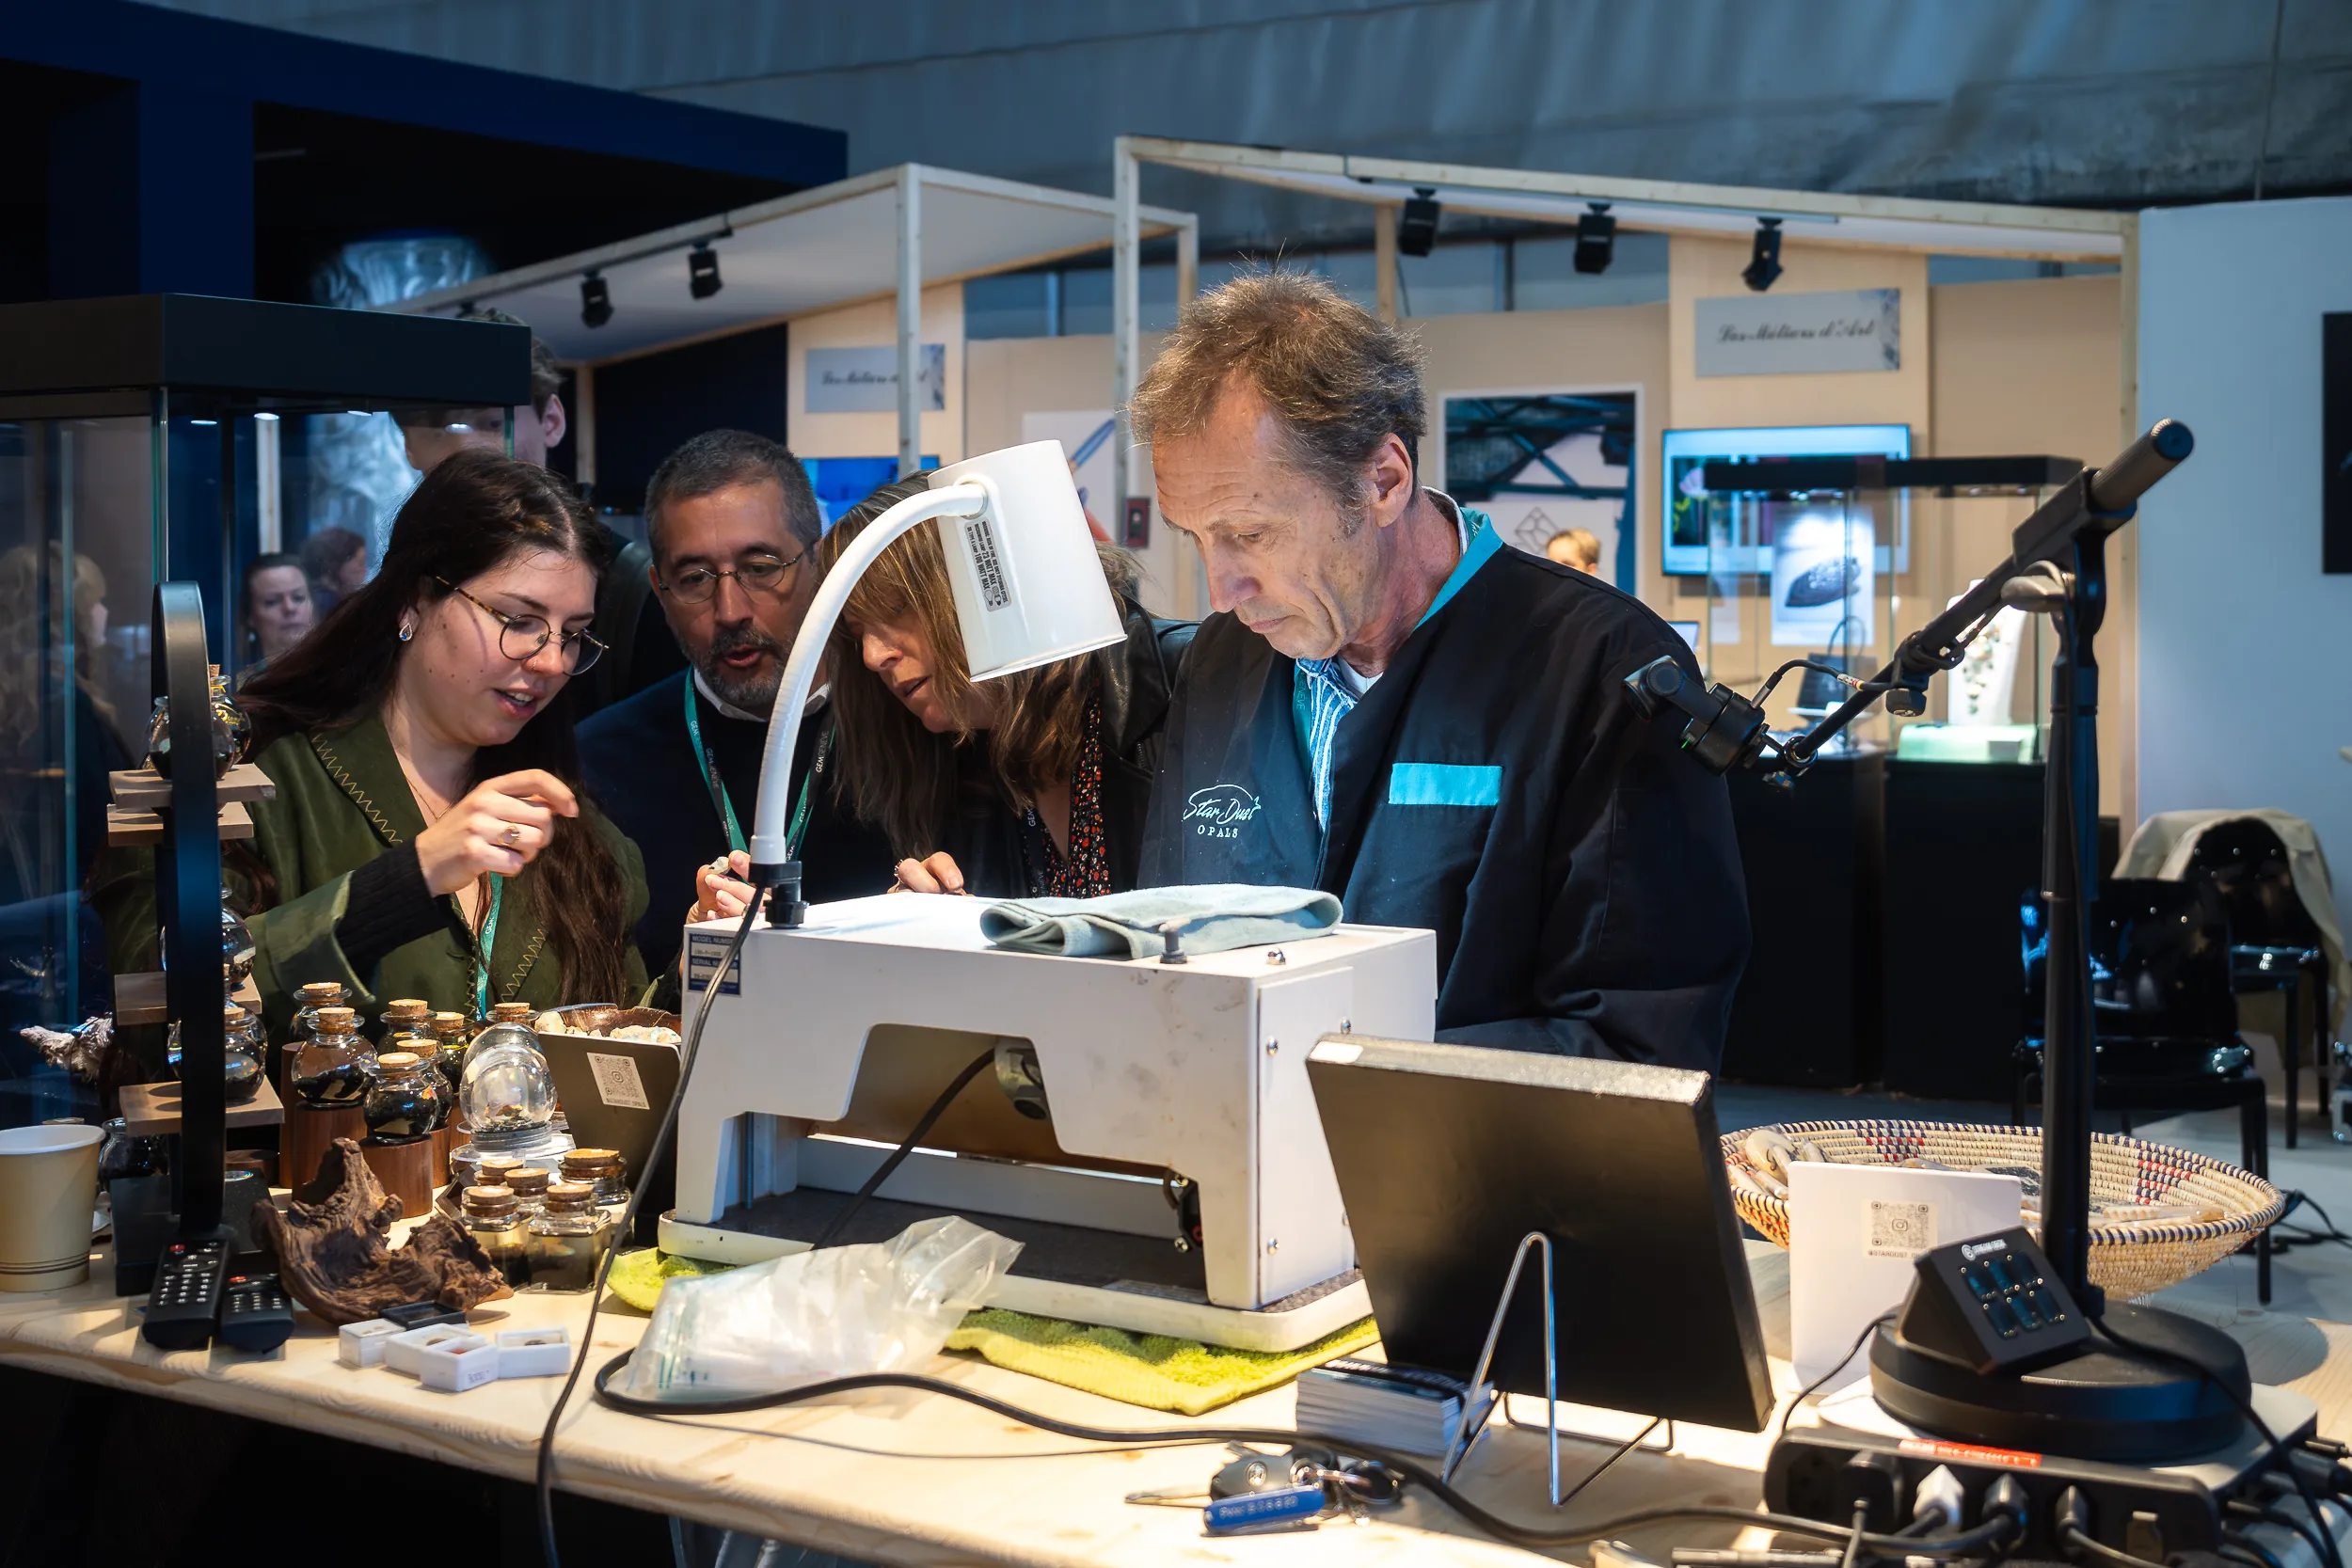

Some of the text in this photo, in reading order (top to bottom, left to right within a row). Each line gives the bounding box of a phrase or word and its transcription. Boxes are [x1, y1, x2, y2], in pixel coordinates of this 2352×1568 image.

[977, 564, 986, 578] WATT
[984, 560, 993, 573] WATT
[981, 578, 990, 590] MAX
[1197, 824, 1239, 838] OPALS
